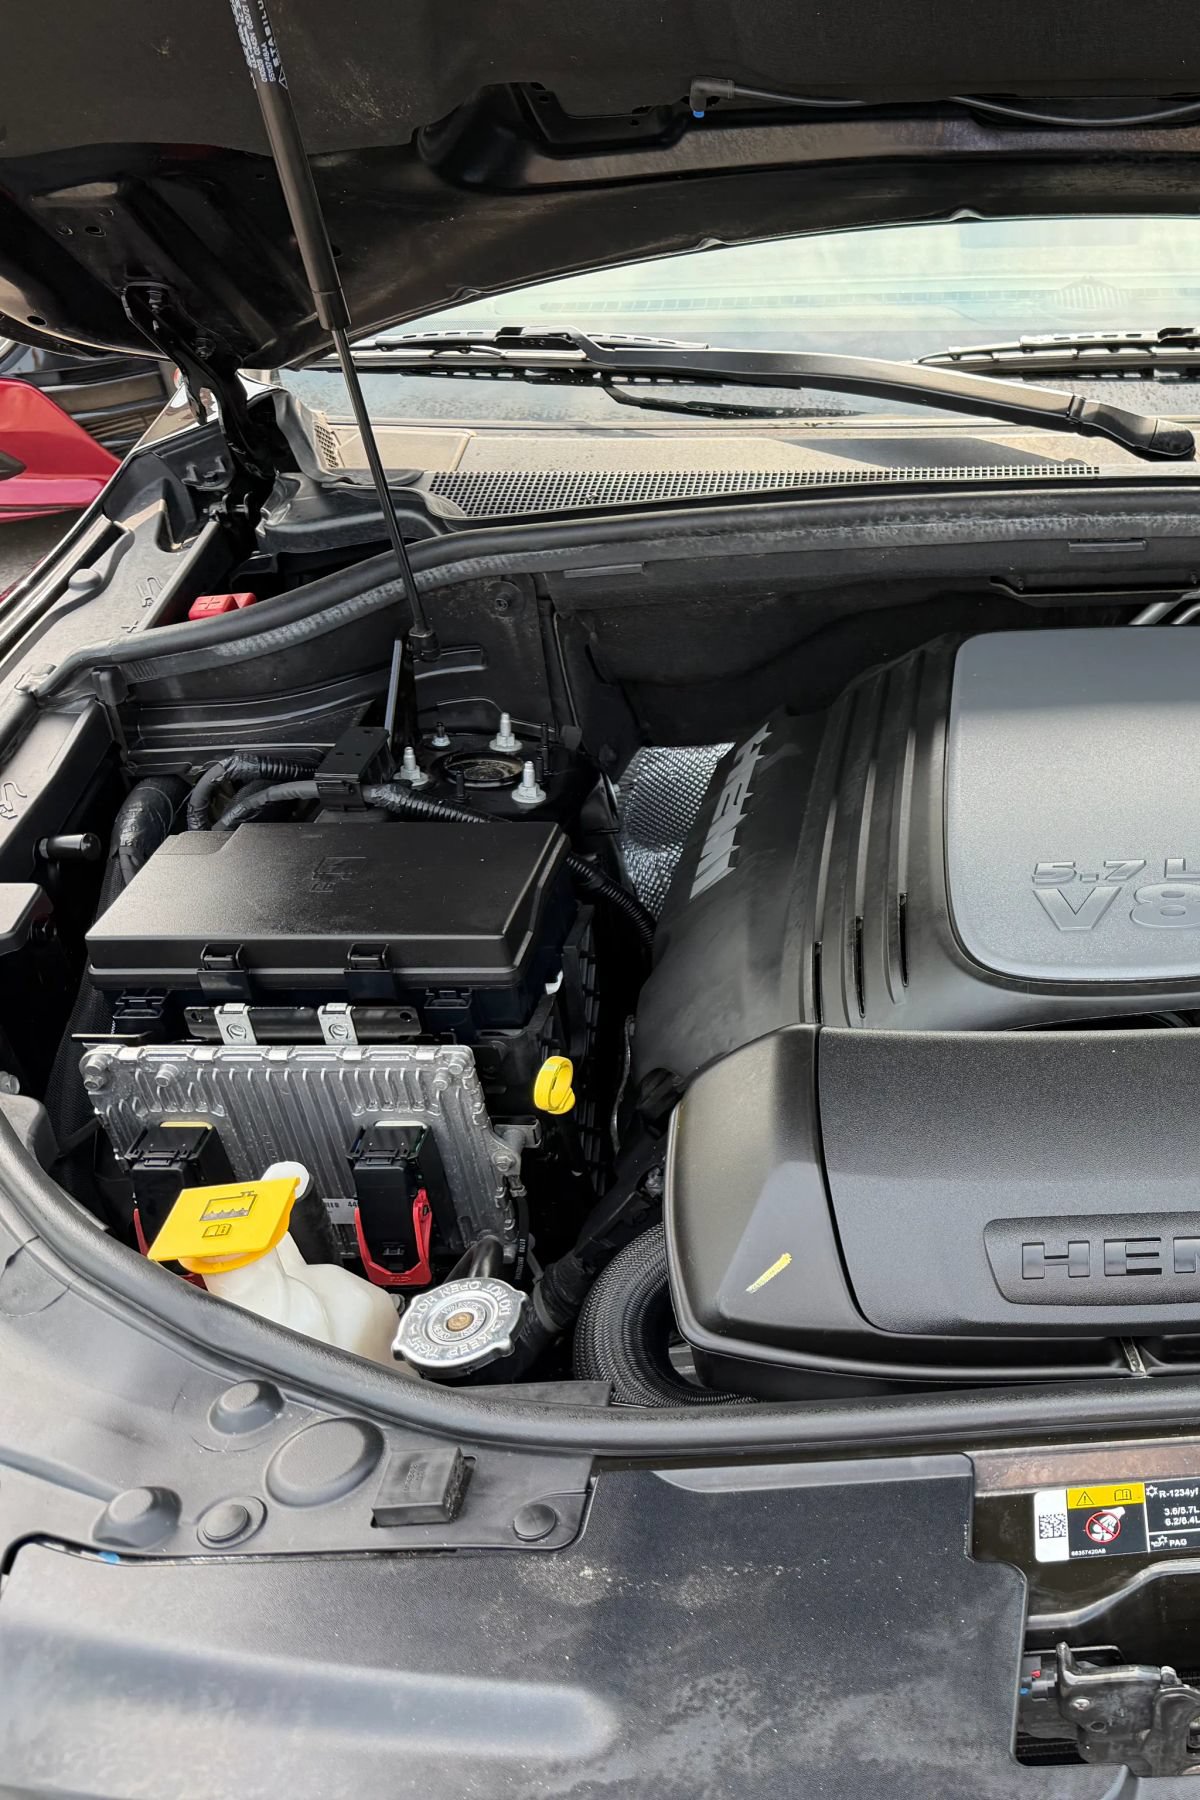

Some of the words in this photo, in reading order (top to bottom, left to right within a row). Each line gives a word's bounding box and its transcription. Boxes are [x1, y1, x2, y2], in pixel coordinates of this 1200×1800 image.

[1032, 859, 1147, 884] 5.7
[440, 1280, 482, 1298] OPEN
[448, 1331, 494, 1357] KEEP
[1158, 1487, 1199, 1499] R-1234yf
[1164, 1506, 1200, 1516] 3.6/5.7L
[1164, 1516, 1200, 1526] 6.2/6.4L
[1169, 1539, 1187, 1547] PAG
